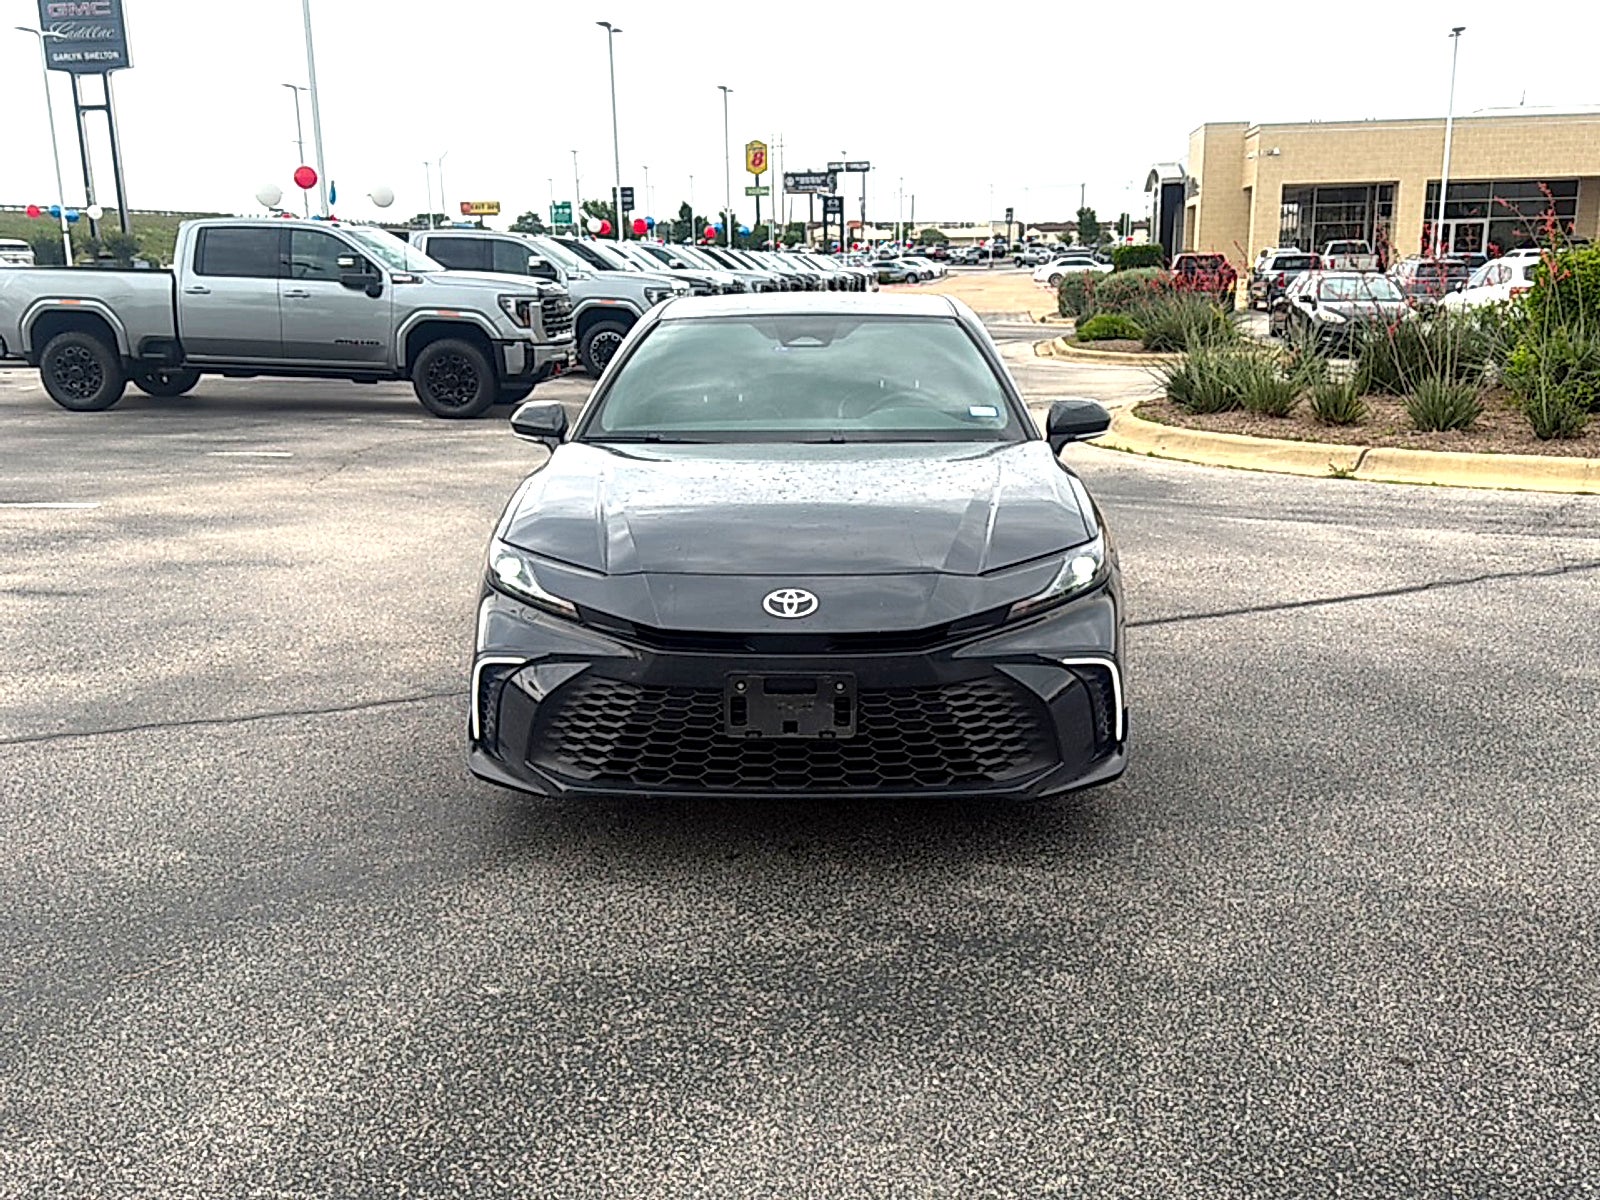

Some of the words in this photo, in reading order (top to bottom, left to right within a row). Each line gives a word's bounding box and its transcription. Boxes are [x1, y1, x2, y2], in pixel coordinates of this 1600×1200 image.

[47, 1, 111, 17] GMC
[50, 21, 115, 43] Cadillac
[84, 51, 120, 61] SHELTON
[751, 151, 765, 168] 8
